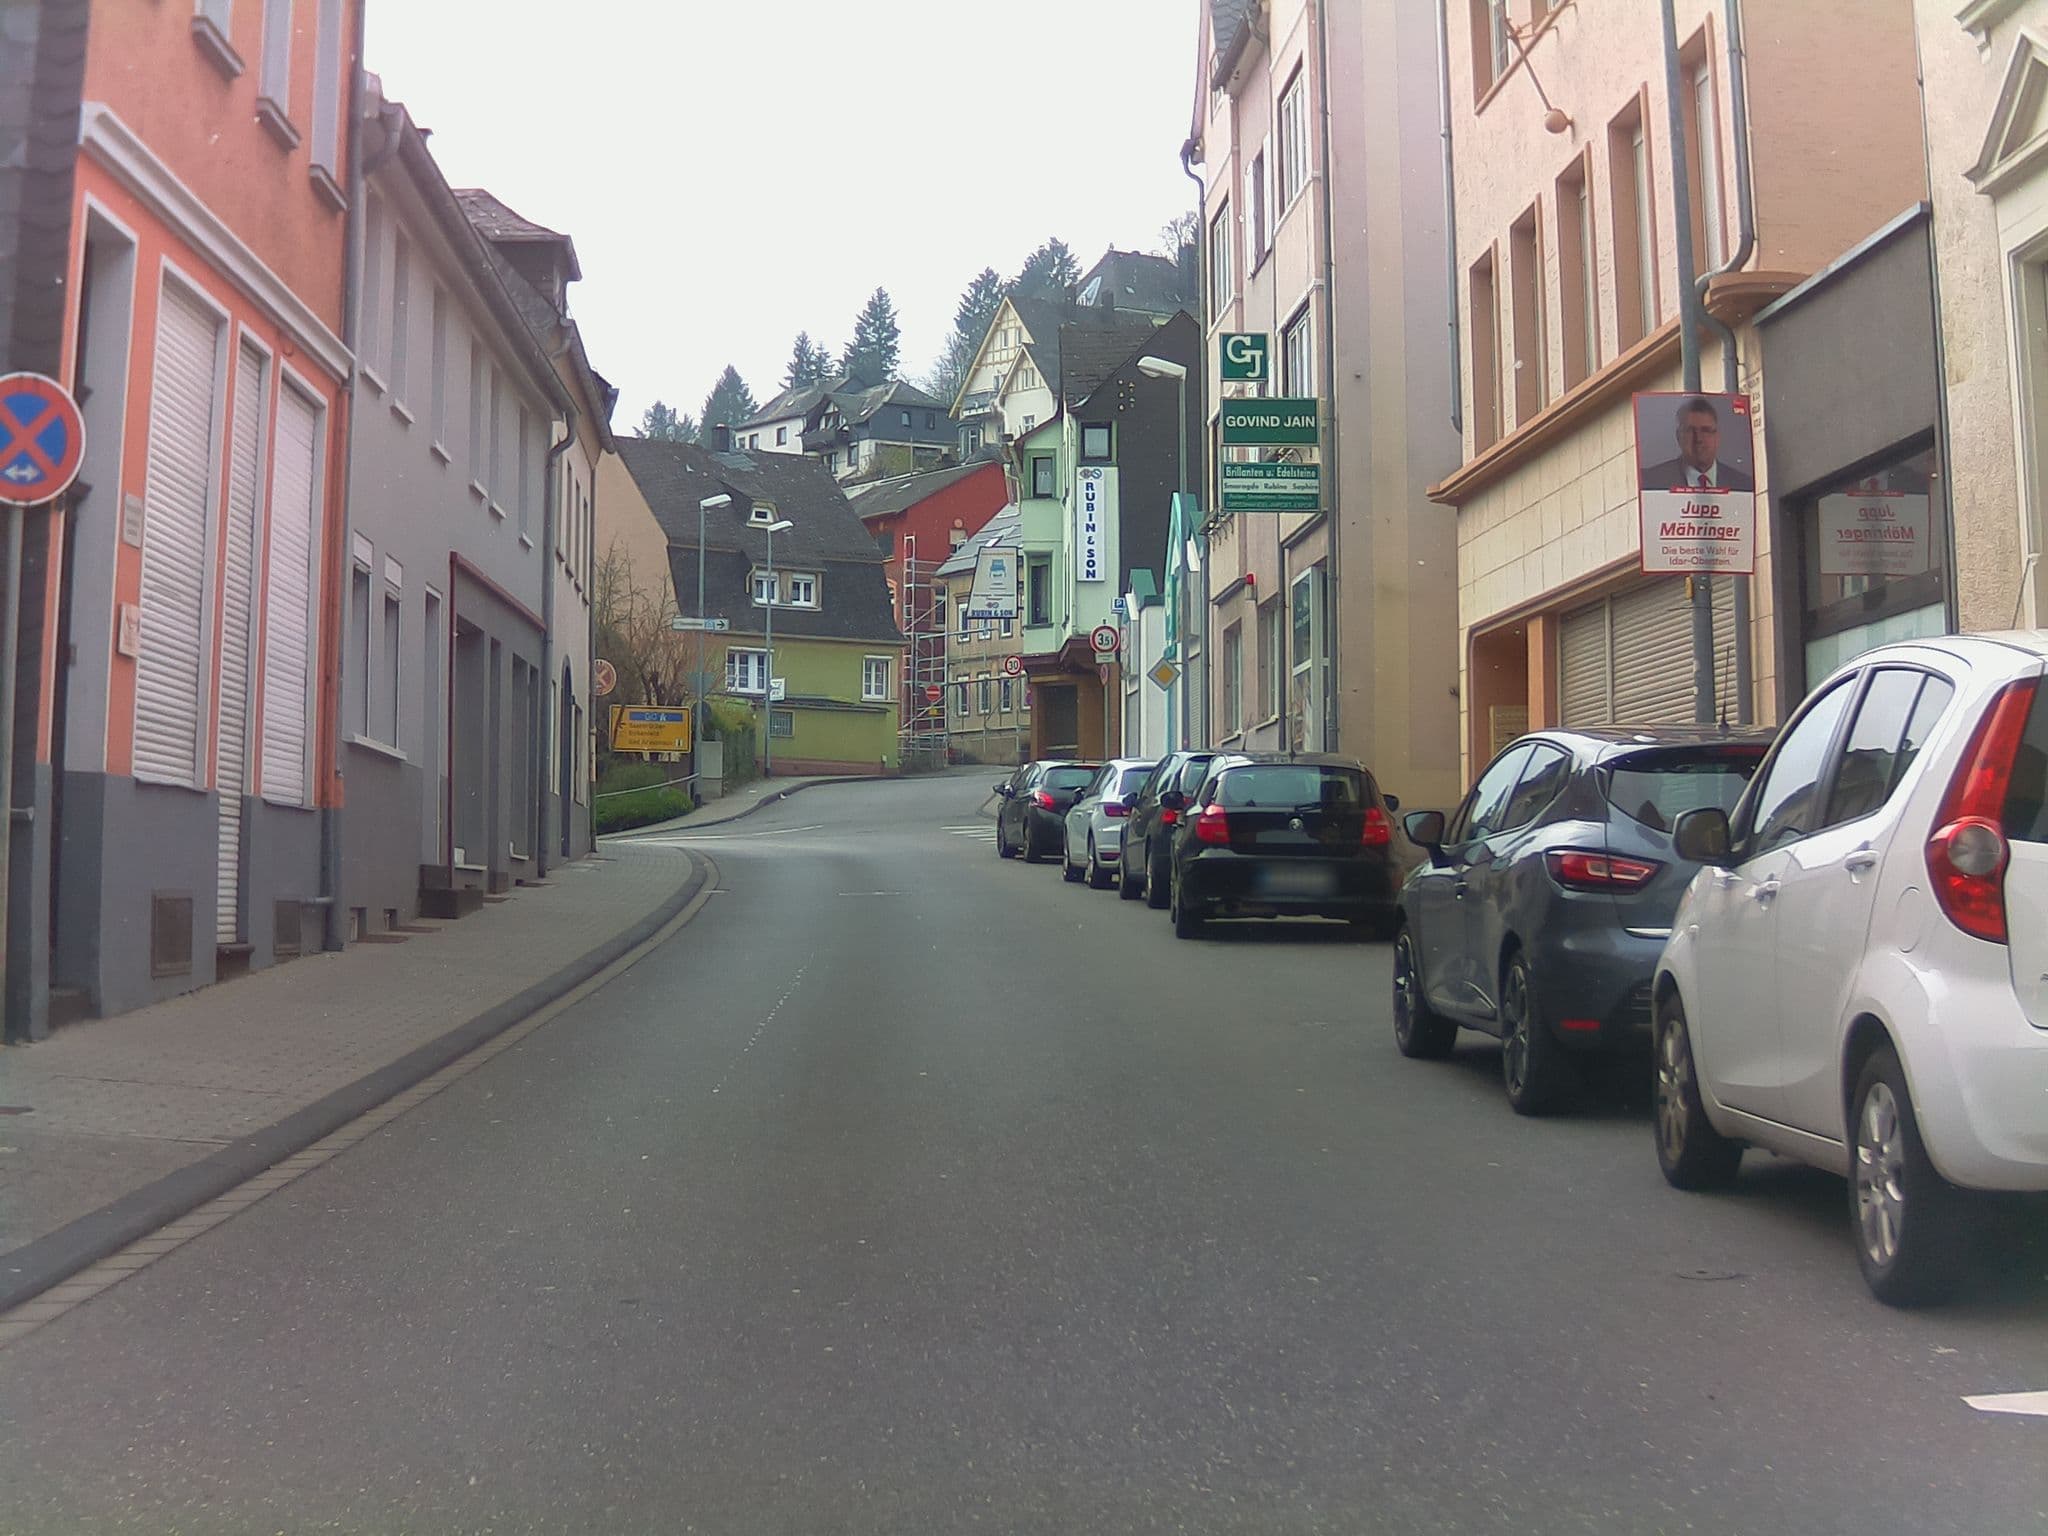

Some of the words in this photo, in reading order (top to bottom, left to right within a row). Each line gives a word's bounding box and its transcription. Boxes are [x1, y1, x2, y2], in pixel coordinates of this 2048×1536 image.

[1226, 415, 1280, 428] GOVIND
[1283, 415, 1315, 428] JAIN
[1225, 466, 1264, 477] Brillanten
[1276, 466, 1316, 477] Edelsteine
[1085, 482, 1096, 532] RUBIN
[1681, 500, 1720, 517] Jupp
[1660, 522, 1740, 538] Mähringer
[1661, 546, 1678, 555] Die
[1679, 546, 1705, 555] beste
[1086, 548, 1096, 578] SON
[1008, 660, 1019, 670] 30
